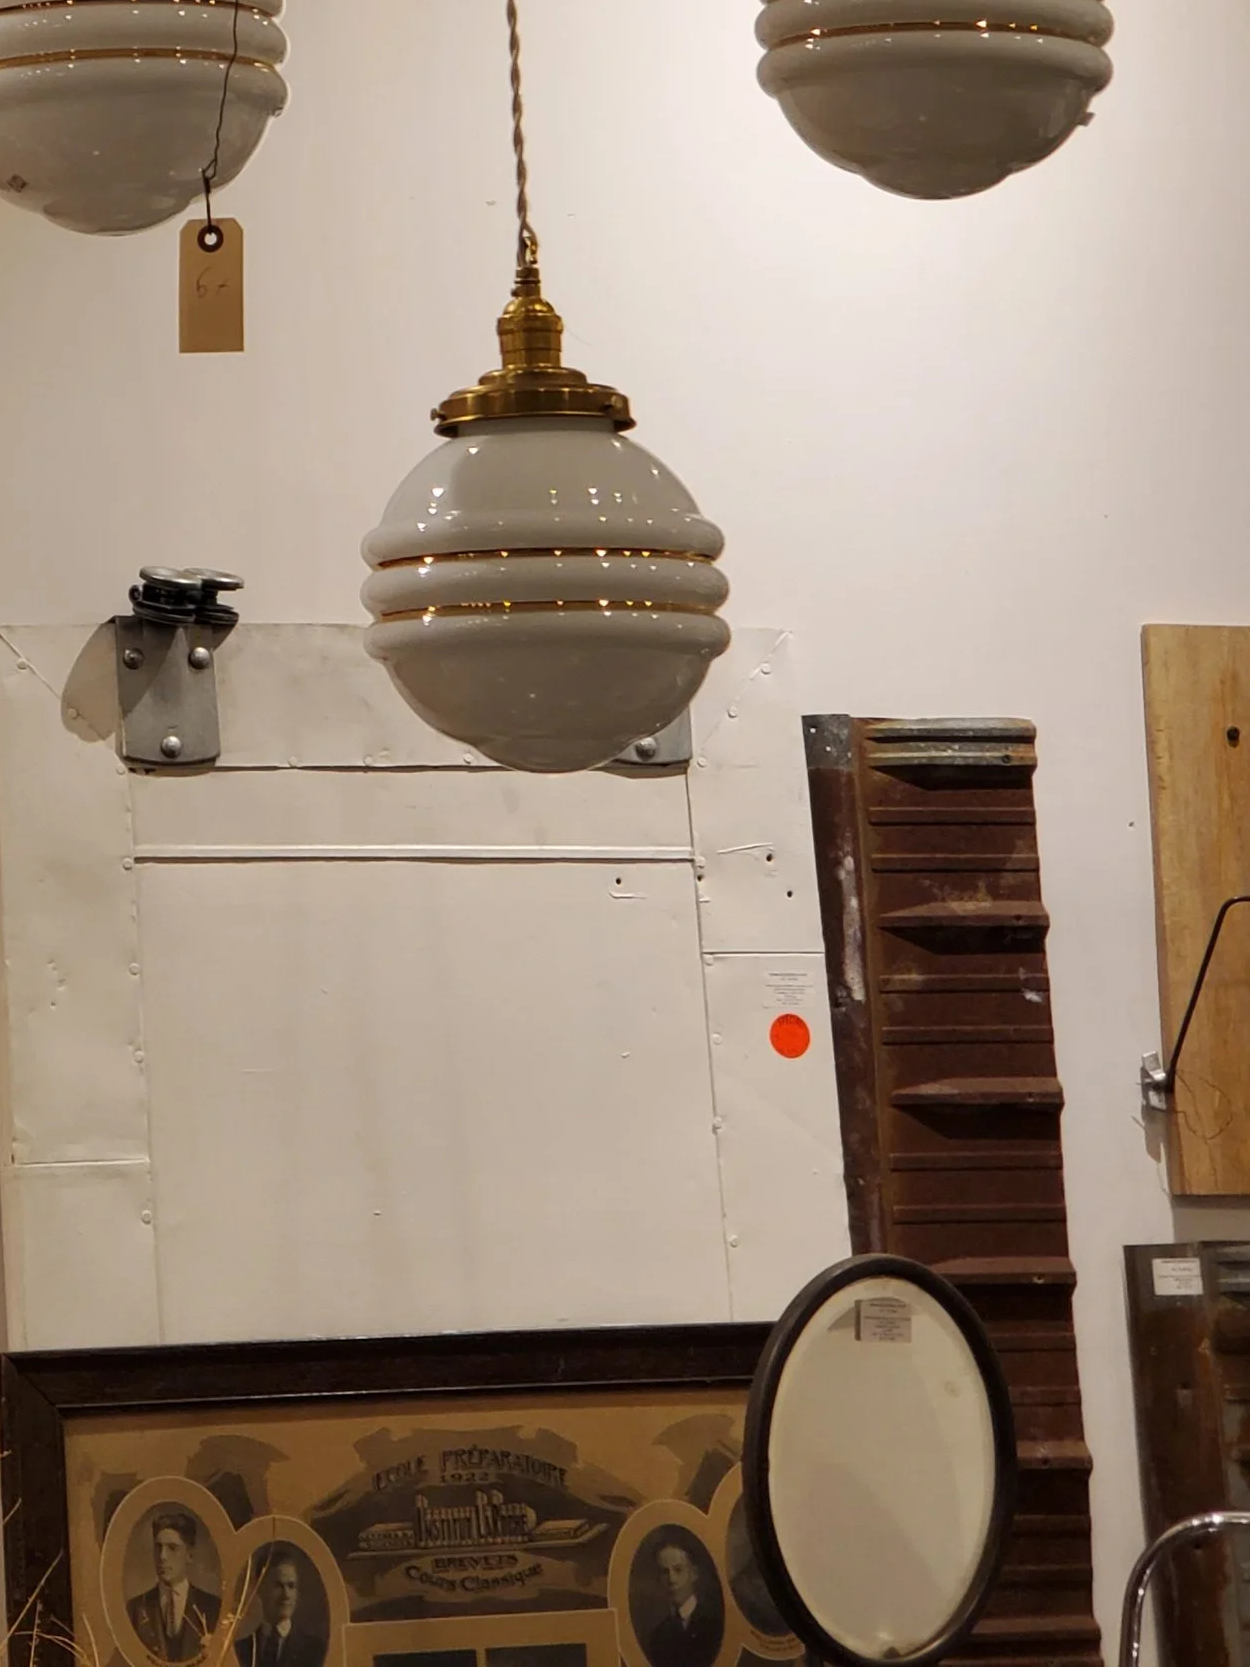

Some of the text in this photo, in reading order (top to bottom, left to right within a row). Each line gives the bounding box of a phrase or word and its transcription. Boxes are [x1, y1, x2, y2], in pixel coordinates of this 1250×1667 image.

[439, 1471, 490, 1484] 1922
[404, 1562, 544, 1593] Cours Classique
